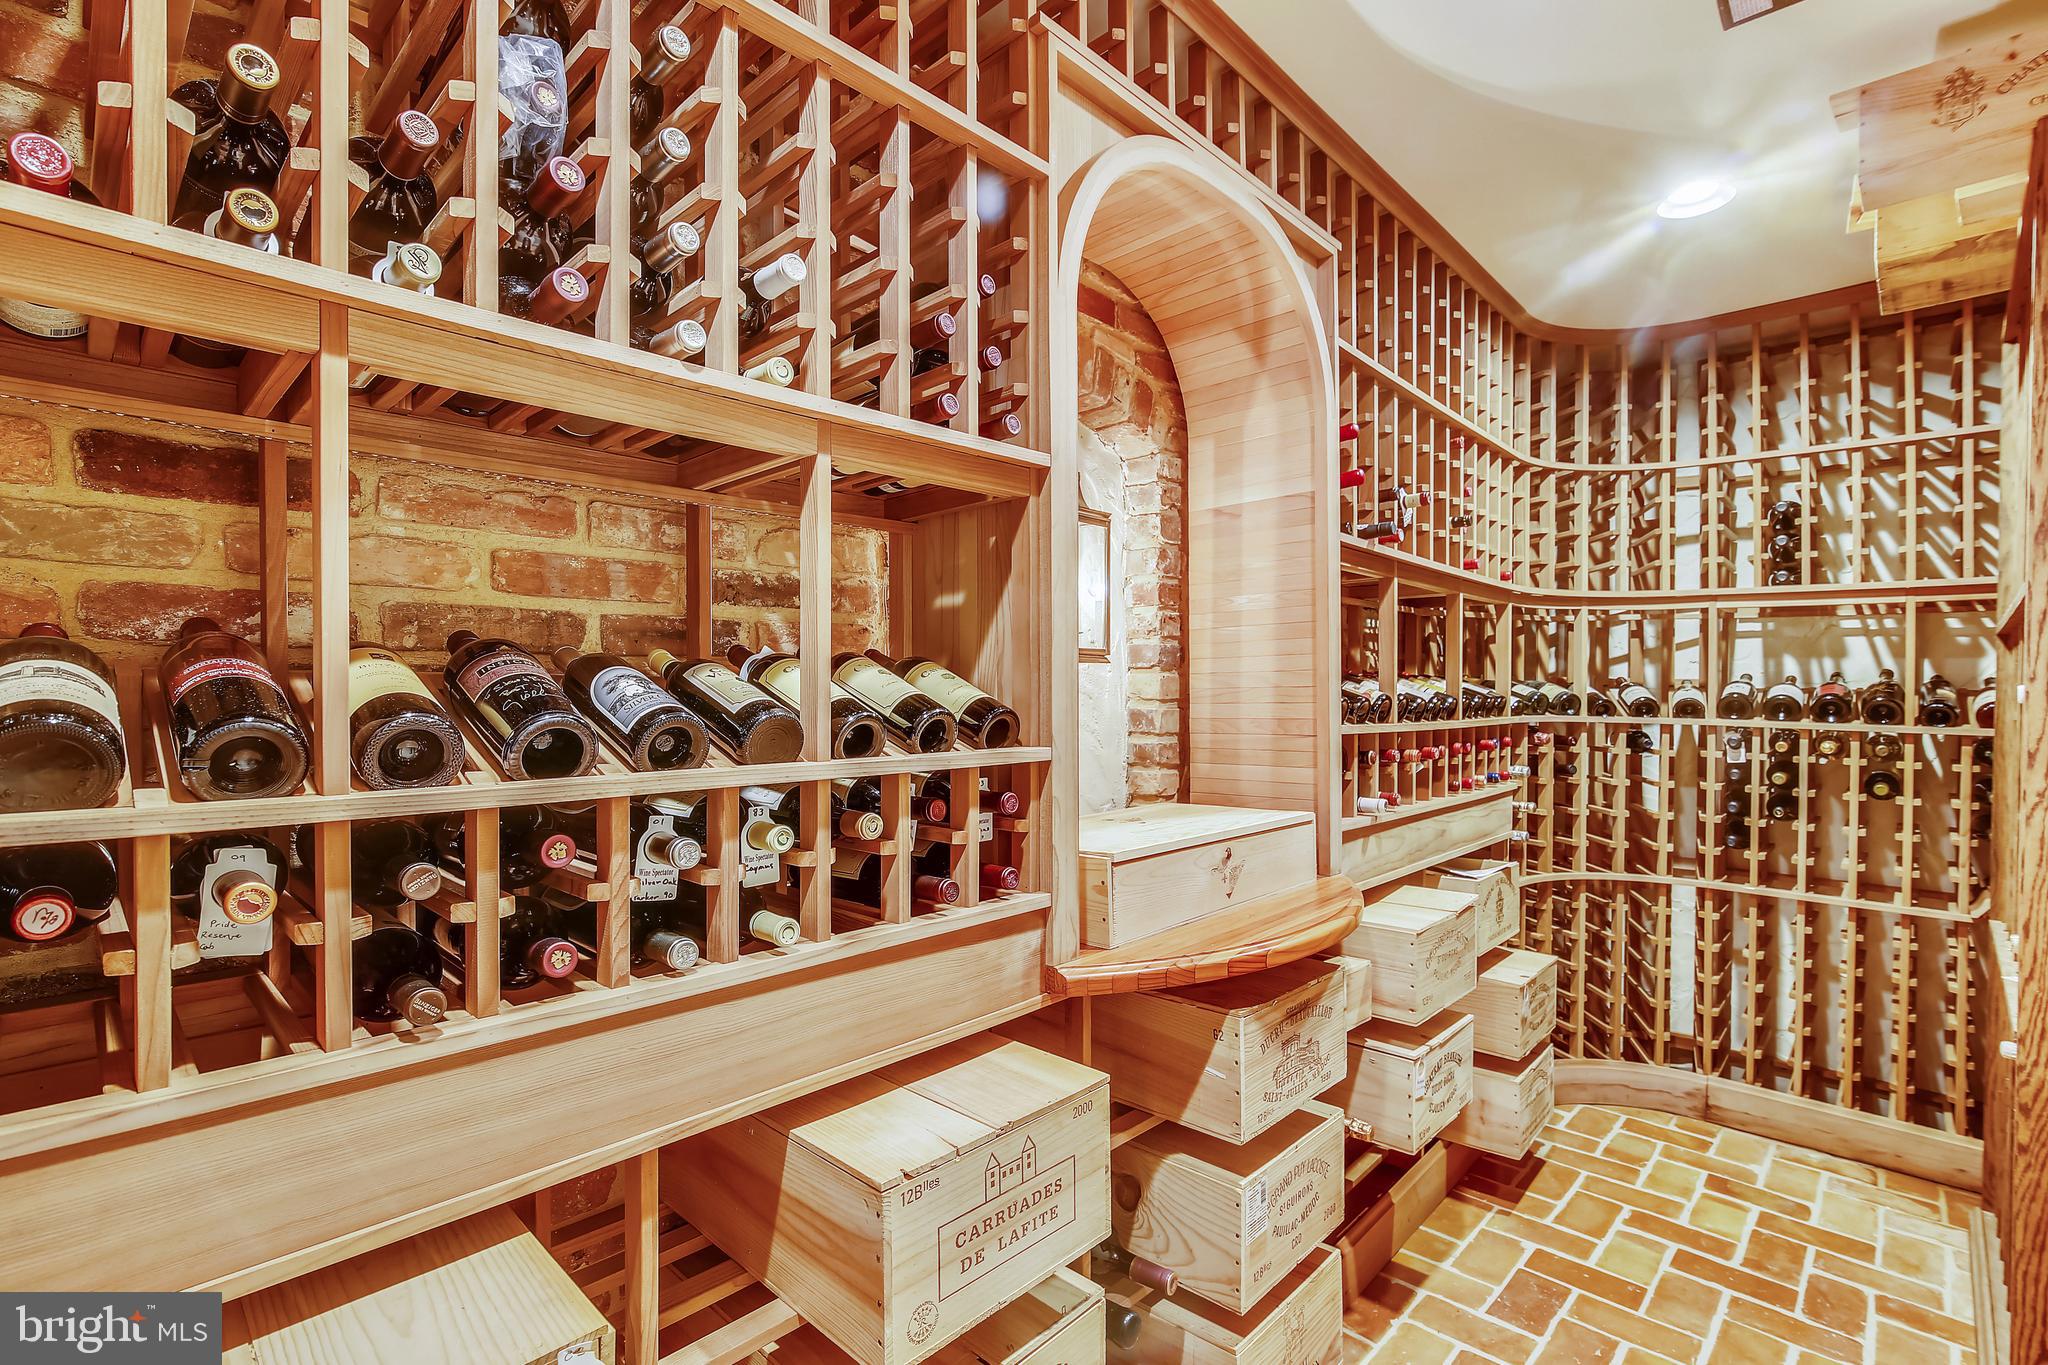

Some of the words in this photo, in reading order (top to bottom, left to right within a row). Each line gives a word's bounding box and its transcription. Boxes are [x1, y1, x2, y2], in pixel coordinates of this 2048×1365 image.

[752, 808, 764, 817] 83
[652, 818, 664, 826] 01
[230, 854, 246, 863] 09
[744, 855, 755, 863] Wine
[755, 852, 775, 862] Spectator
[639, 868, 651, 876] Wine
[652, 868, 674, 878] Spectator
[640, 878, 662, 887] ilver
[663, 878, 677, 886] Oak
[663, 891, 674, 899] 90
[209, 919, 238, 929] Pride
[200, 931, 242, 940] Reserve
[1072, 1100, 1094, 1120] 2000
[1270, 1170, 1293, 1208] GRAND
[1294, 1160, 1306, 1180] PUY
[1307, 1157, 1331, 1180] LACOSTE
[1286, 1180, 1314, 1210] GUIRONS
[954, 1177, 1063, 1249] CARRUADES
[960, 1249, 985, 1275] DE
[998, 1204, 1060, 1252] LAFITE
